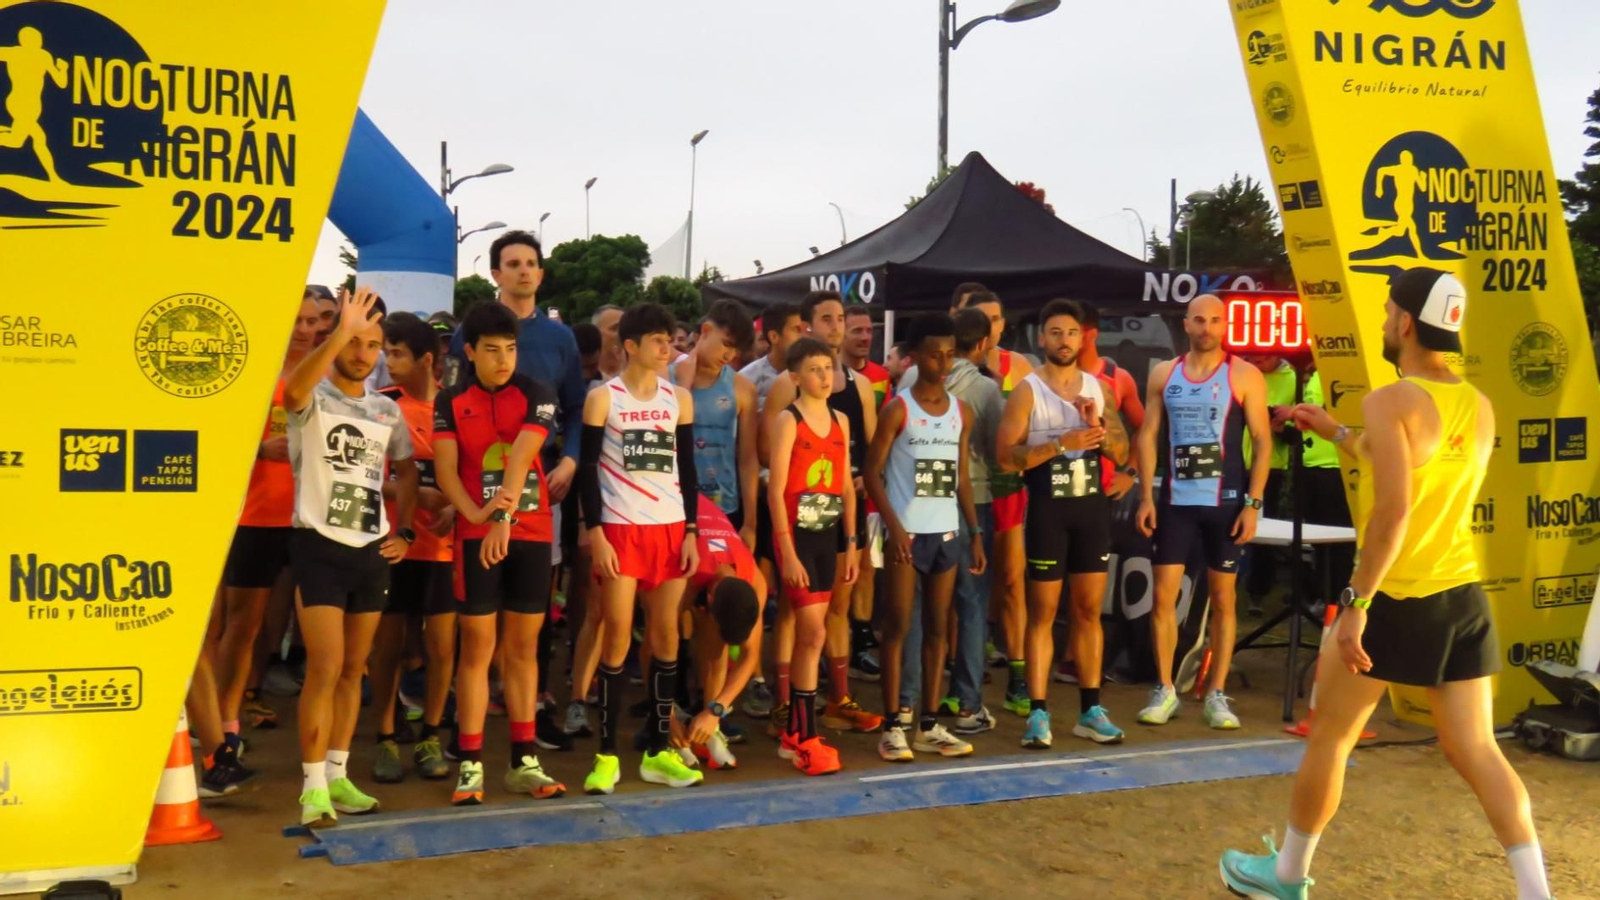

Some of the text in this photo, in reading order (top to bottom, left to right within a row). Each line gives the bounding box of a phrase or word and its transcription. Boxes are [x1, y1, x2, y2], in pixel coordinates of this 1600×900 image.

[1313, 30, 1506, 71] NIGRÁN
[72, 55, 297, 121] NOCTURNA
[1342, 79, 1488, 98] Equilibrio Natural
[72, 117, 104, 149] DE
[1428, 168, 1547, 204] NOCTURNA
[171, 190, 295, 243] 2024
[1429, 211, 1447, 233] DE
[1482, 258, 1548, 292] 2024
[810, 271, 876, 303] NOKO
[150, 301, 173, 317] The
[178, 297, 221, 311] coffee
[223, 311, 244, 338] land
[1228, 300, 1312, 347] 00:0
[3, 331, 78, 348] BREIRA
[135, 336, 248, 356] Coffee & Meal
[1315, 333, 1356, 350] kami
[150, 371, 171, 390] The
[176, 384, 219, 396] coffee
[221, 358, 243, 383] land
[618, 410, 671, 422] TREGA
[64, 434, 119, 454] ven
[623, 444, 643, 456] 614
[64, 453, 100, 472] us
[163, 454, 193, 465] CAFÉ
[1175, 457, 1190, 468] 617
[141, 475, 193, 485] PENSIÓN
[157, 466, 193, 475] TAPAS
[915, 472, 933, 484] 646
[1051, 474, 1070, 485] 590
[330, 497, 352, 512] 437
[9, 553, 173, 602] NosoCao
[28, 603, 147, 620] Frio y Caliente
